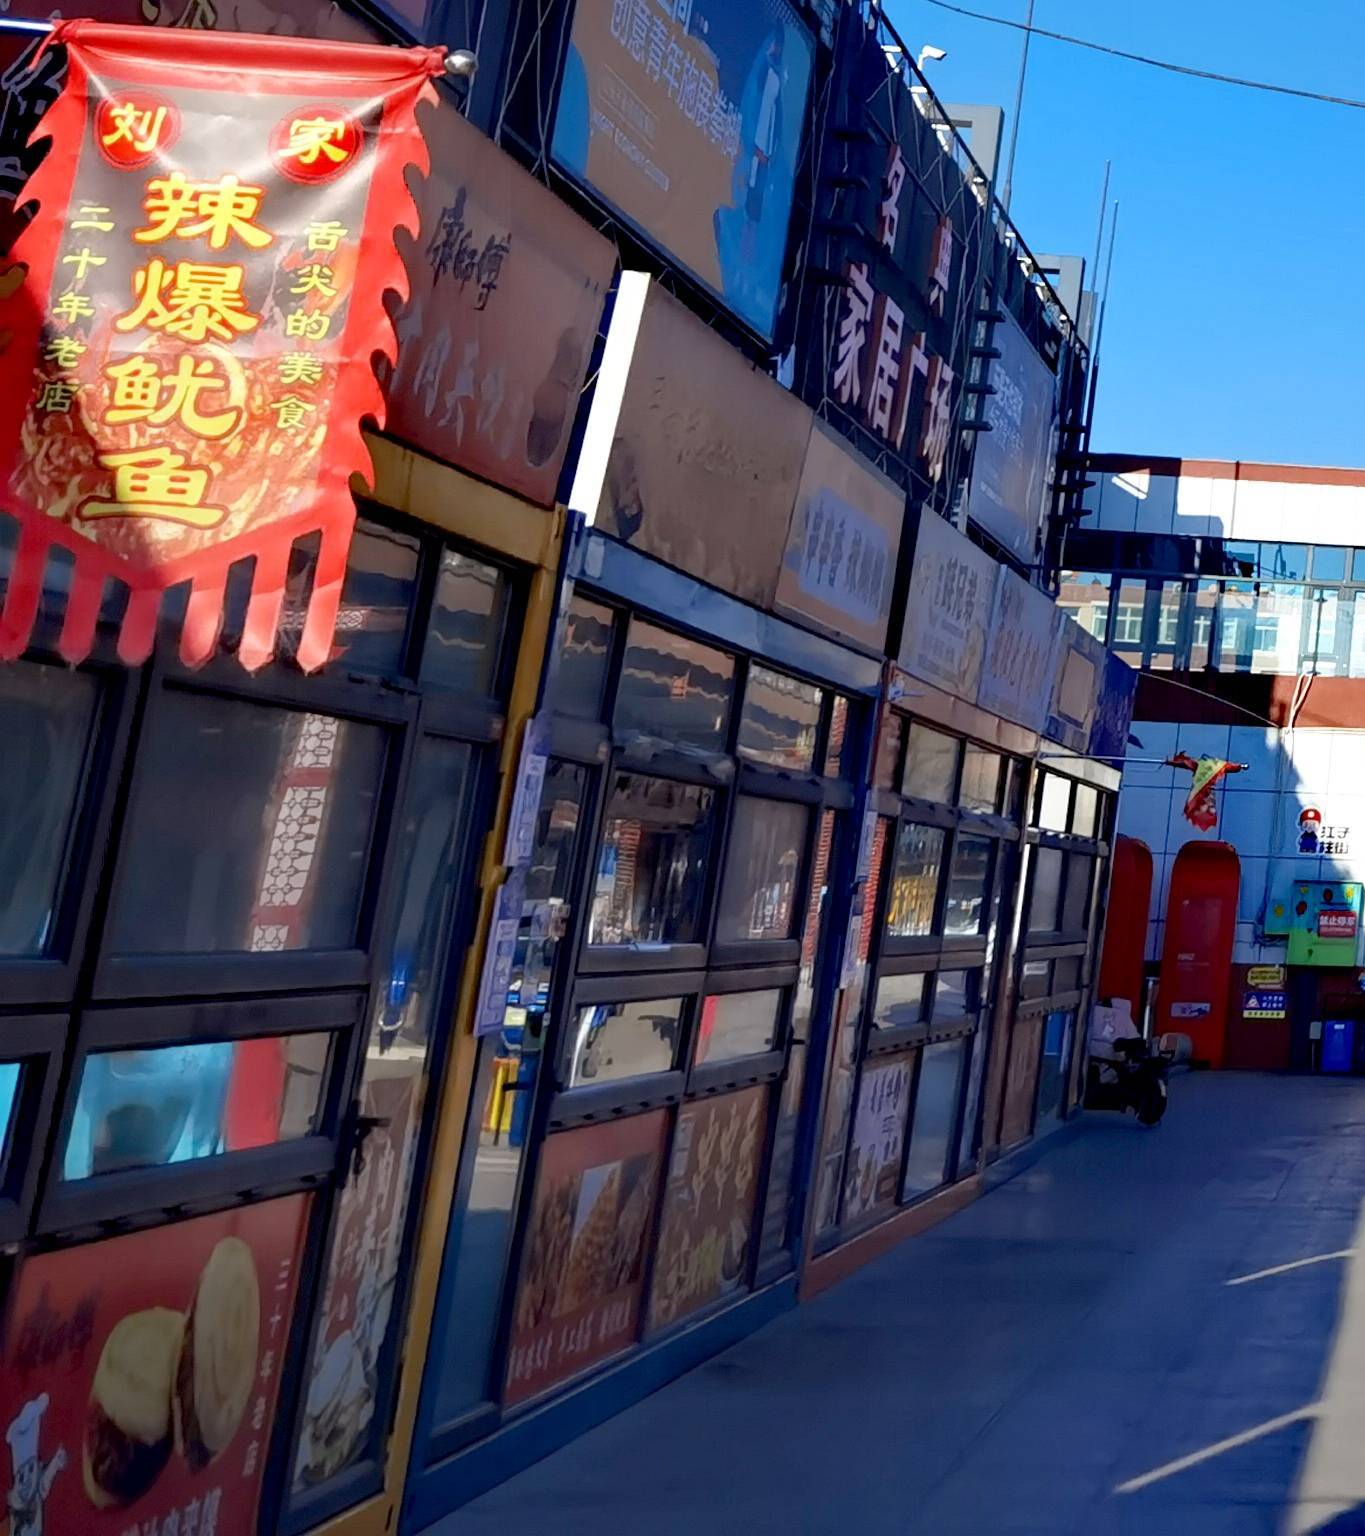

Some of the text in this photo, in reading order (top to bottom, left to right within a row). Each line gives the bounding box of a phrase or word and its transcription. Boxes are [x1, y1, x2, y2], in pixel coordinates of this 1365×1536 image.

[36, 205, 116, 417] 二十年老店
[80, 173, 275, 527] 辣爆鱿鱼
[270, 219, 349, 432] 舌尖的美食
[834, 261, 955, 484] 家居广场
